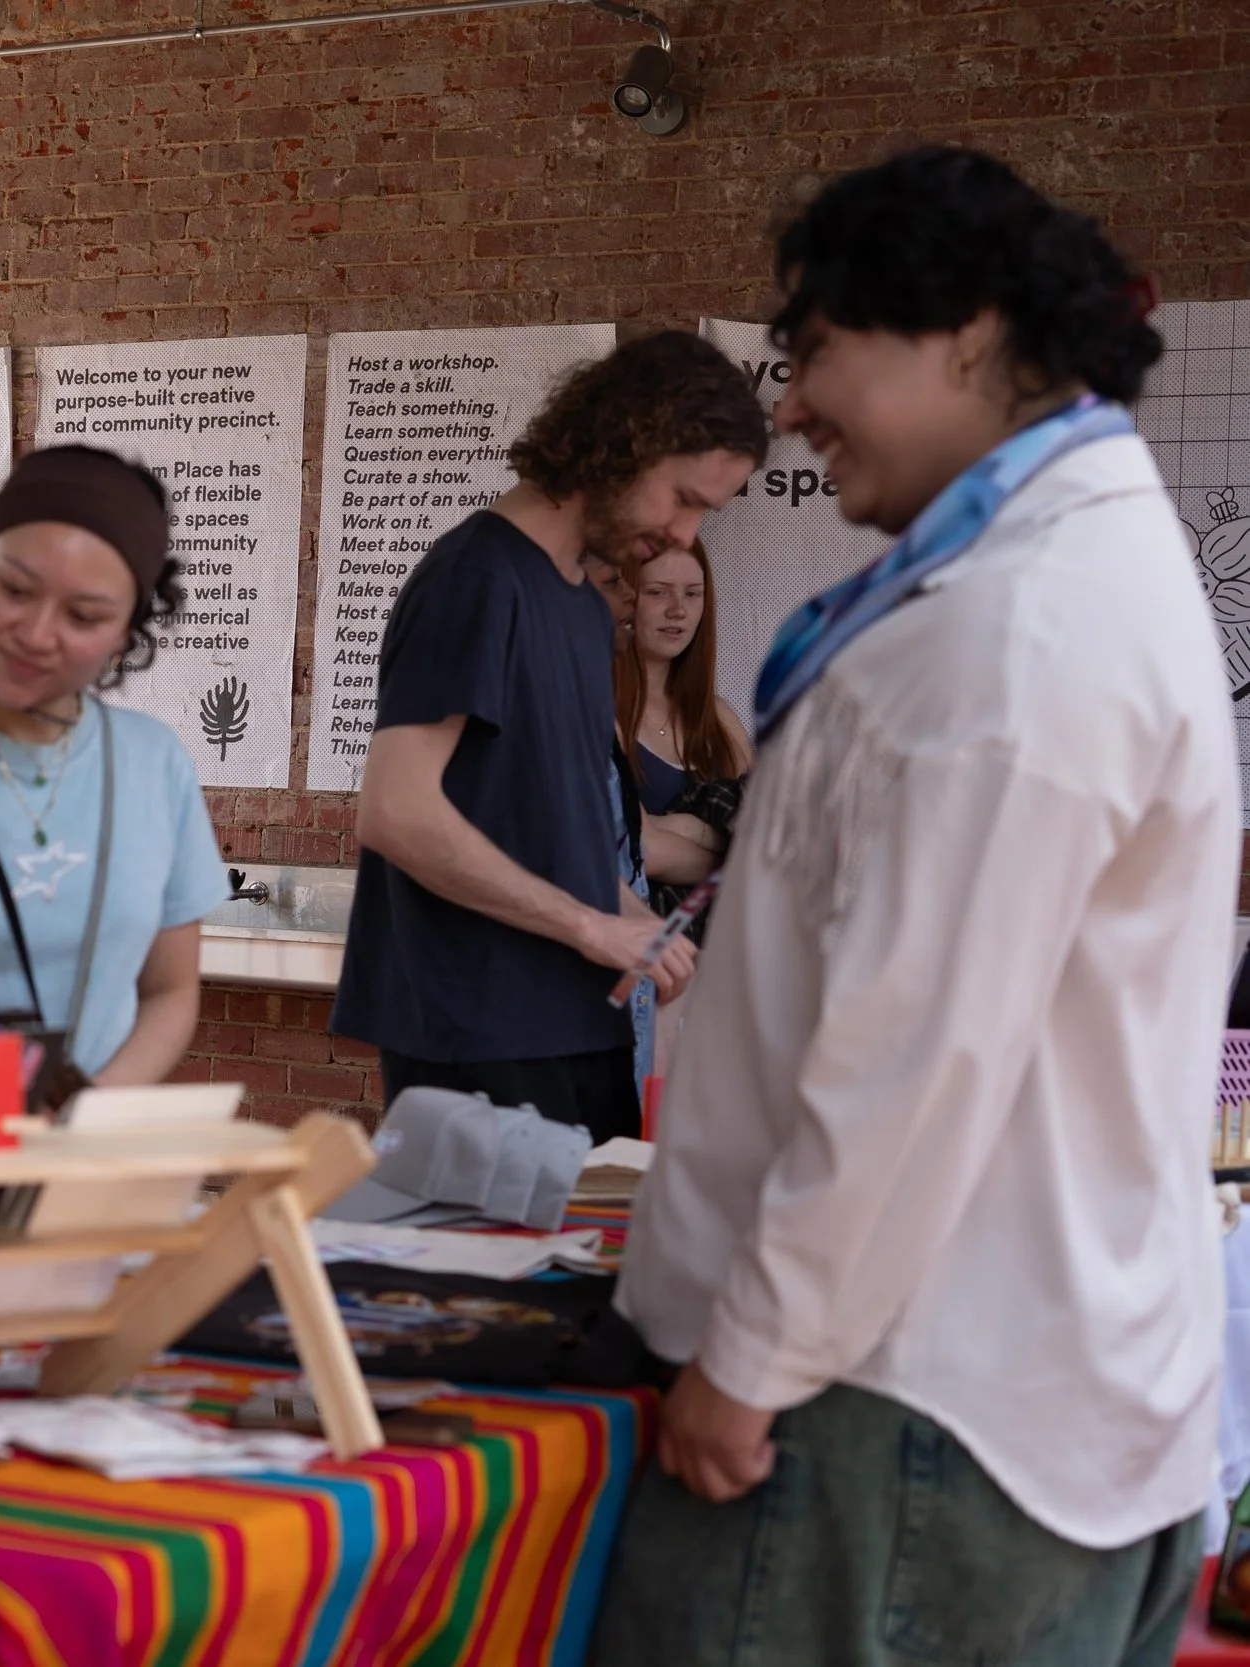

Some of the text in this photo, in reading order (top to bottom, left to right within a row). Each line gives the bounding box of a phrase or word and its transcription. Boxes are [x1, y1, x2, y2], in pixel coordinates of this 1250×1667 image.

[348, 353, 499, 373] Host a workshop.
[56, 365, 252, 386] Welcome to your new
[348, 376, 454, 394] Trade a skill.
[55, 386, 256, 413] purpose-built creative
[347, 399, 498, 418] Teach something.
[54, 411, 280, 434] and community precinct.
[344, 422, 495, 442] Learn something.
[344, 445, 510, 465] Question everythin
[174, 461, 224, 479] Place
[229, 460, 261, 477] has
[343, 468, 472, 485] Curate a show.
[171, 484, 262, 503] of flexible
[342, 491, 501, 511] Be part of an exhi
[185, 513, 250, 531] spaces
[342, 514, 433, 530] Work on it.
[166, 533, 258, 555] ommunity
[339, 537, 433, 552] Meet abou
[338, 559, 408, 579] Develop
[194, 583, 231, 600] well
[237, 586, 258, 600] as
[337, 582, 399, 598] Make a
[336, 604, 391, 620] Host a
[174, 633, 249, 649] creative
[335, 627, 378, 646] Keep
[333, 649, 381, 665] Atten
[333, 672, 373, 688] Lean
[332, 694, 377, 710] Learn
[331, 716, 372, 733] Rehe
[330, 738, 368, 755] Thin
